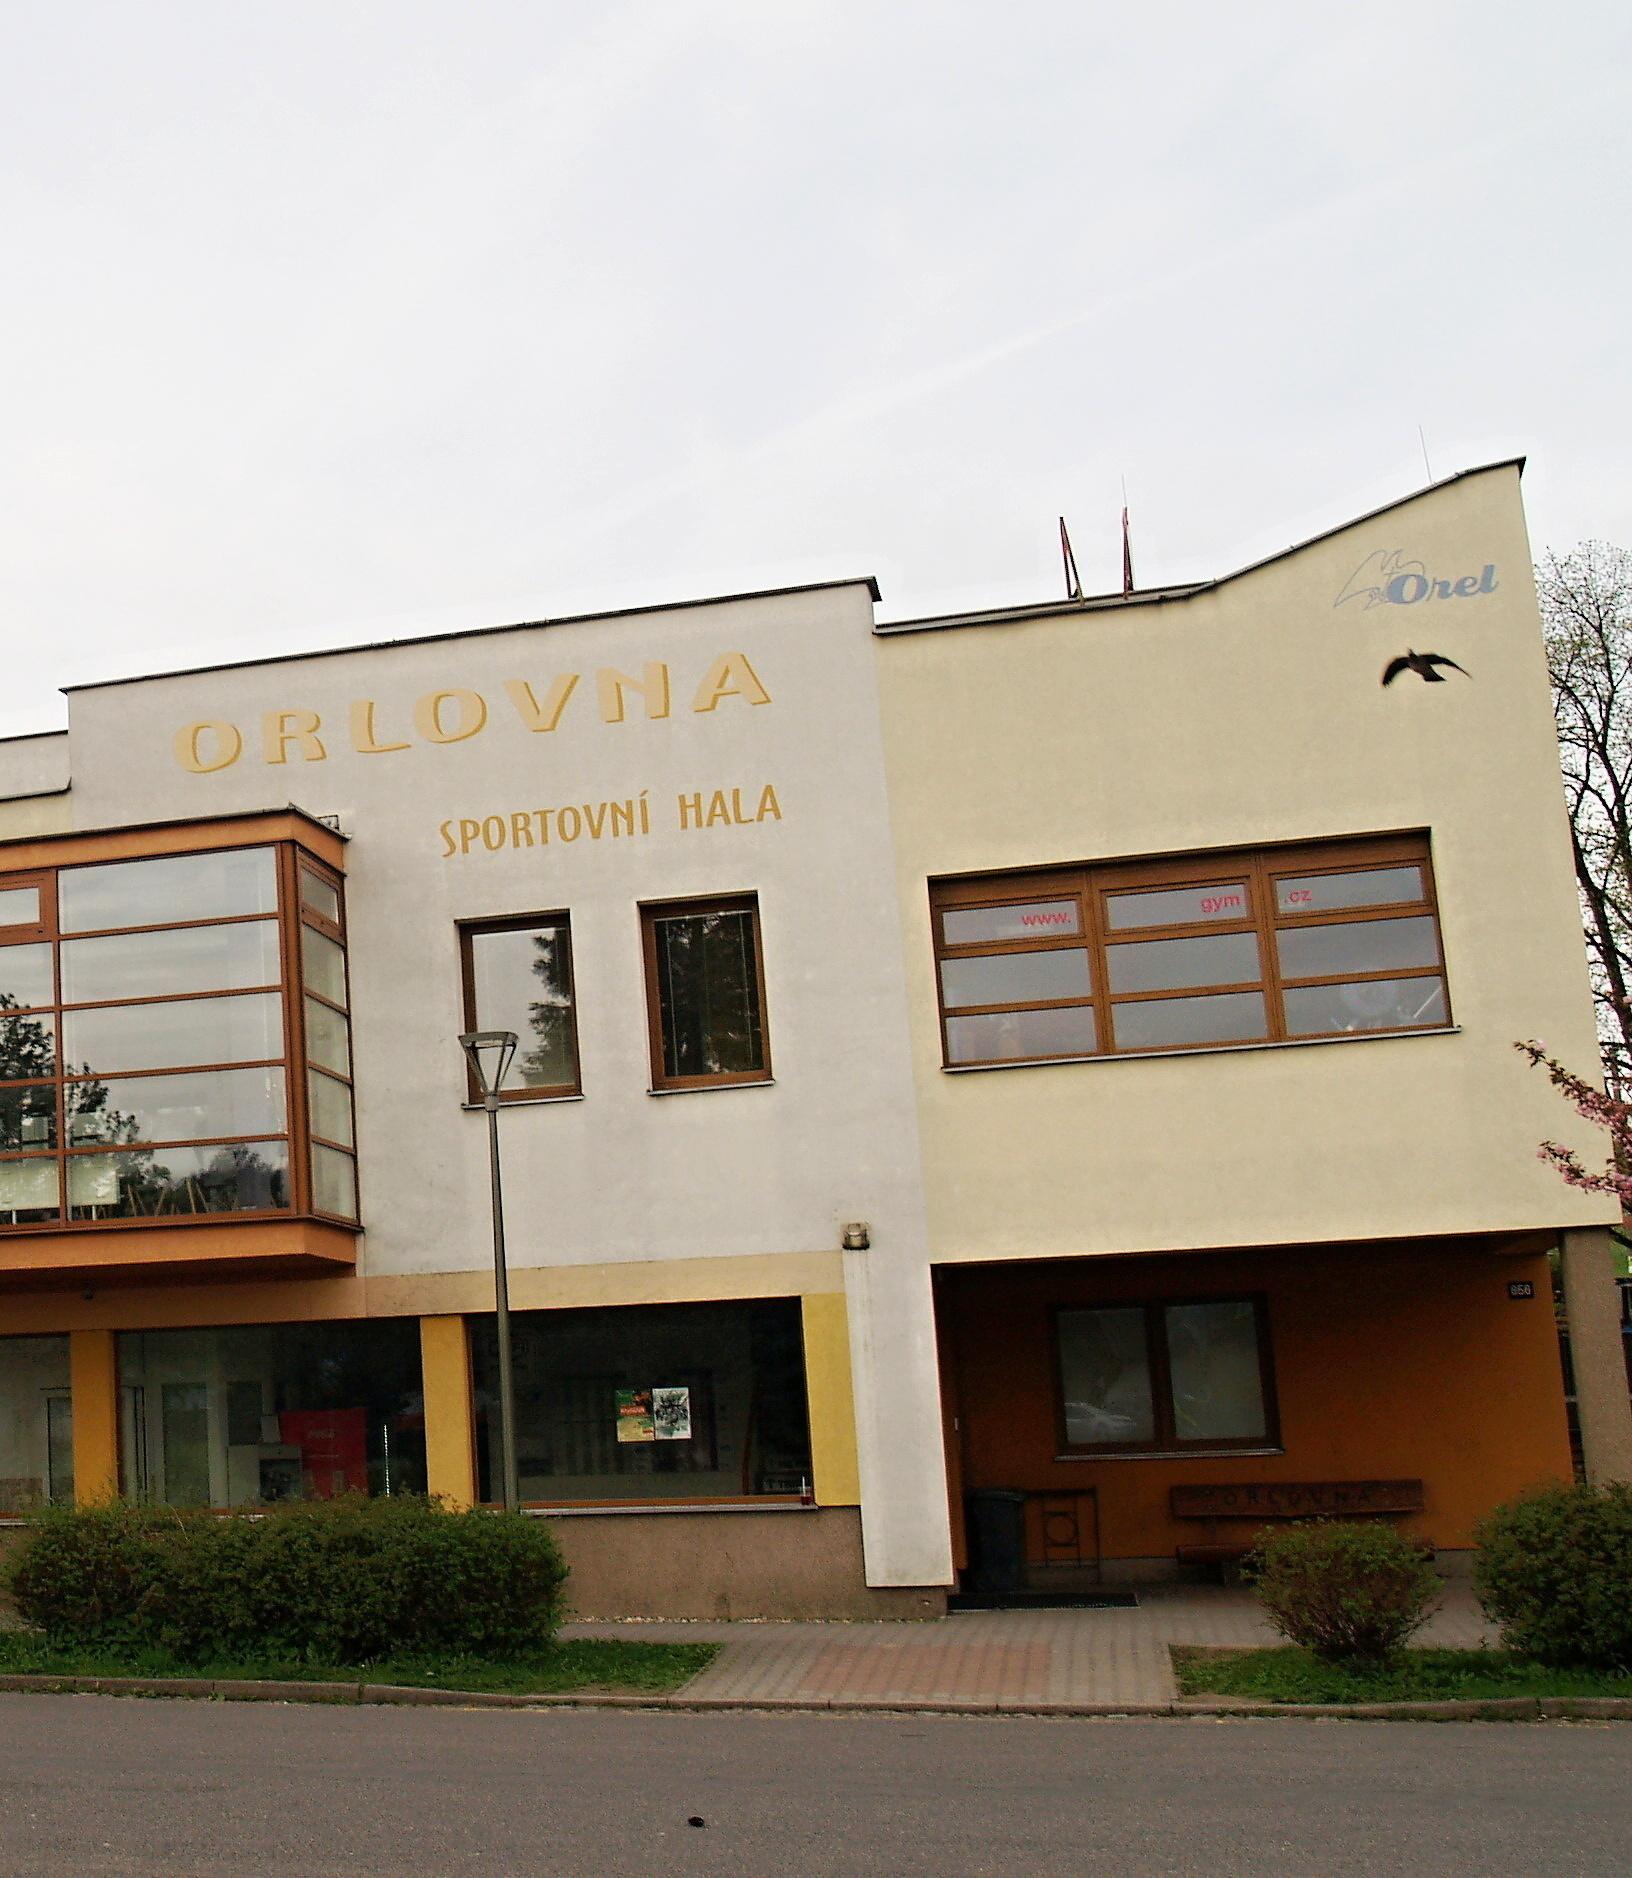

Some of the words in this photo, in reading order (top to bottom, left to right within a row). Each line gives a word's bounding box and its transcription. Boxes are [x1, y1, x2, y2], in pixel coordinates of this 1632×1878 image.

[1386, 563, 1499, 605] Orel
[172, 650, 773, 774] ORLOVNA
[439, 790, 650, 858] SPORTOVNÍ
[677, 784, 784, 830] HALA
[1021, 912, 1071, 926] www.
[1200, 892, 1241, 914] gym
[1284, 890, 1312, 904] .cz
